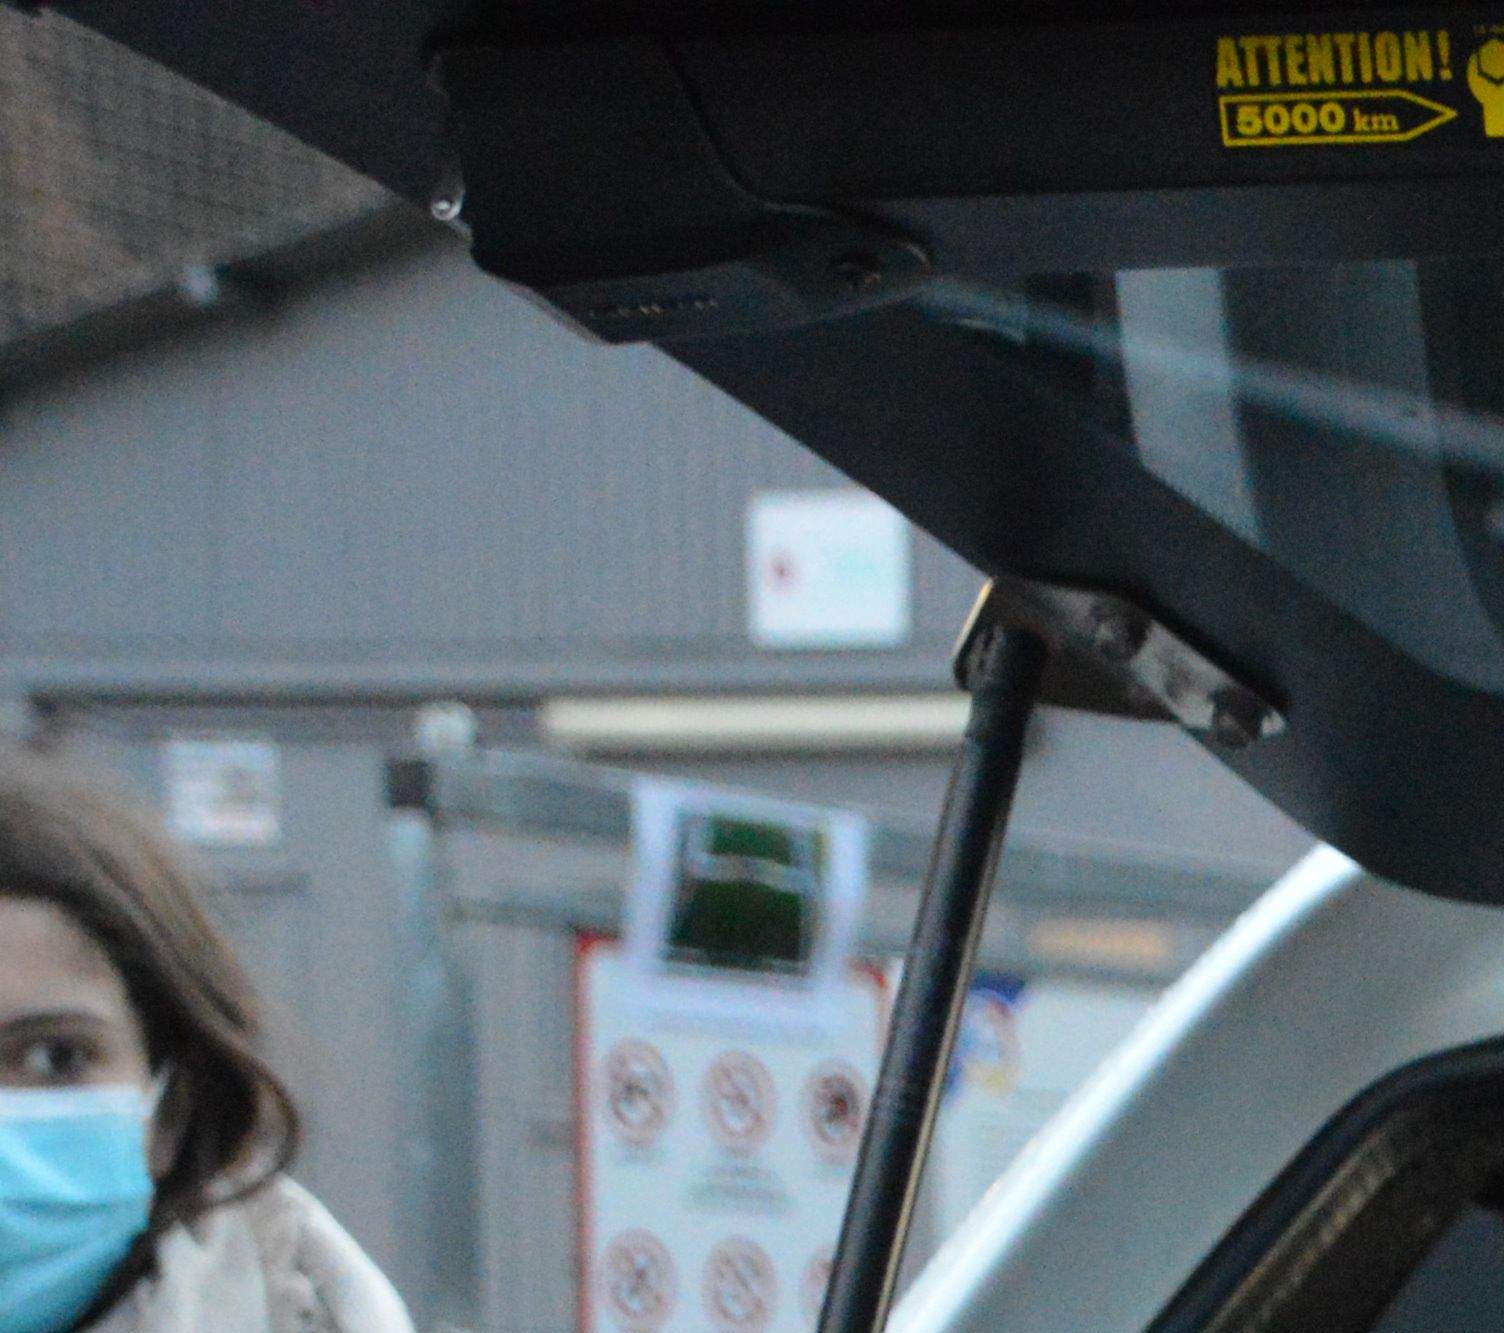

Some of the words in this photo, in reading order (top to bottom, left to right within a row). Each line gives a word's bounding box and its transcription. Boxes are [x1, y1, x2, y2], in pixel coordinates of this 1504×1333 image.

[1216, 30, 1452, 88] ATTENTION!
[1236, 102, 1345, 135] 5000
[1353, 108, 1399, 131] km
